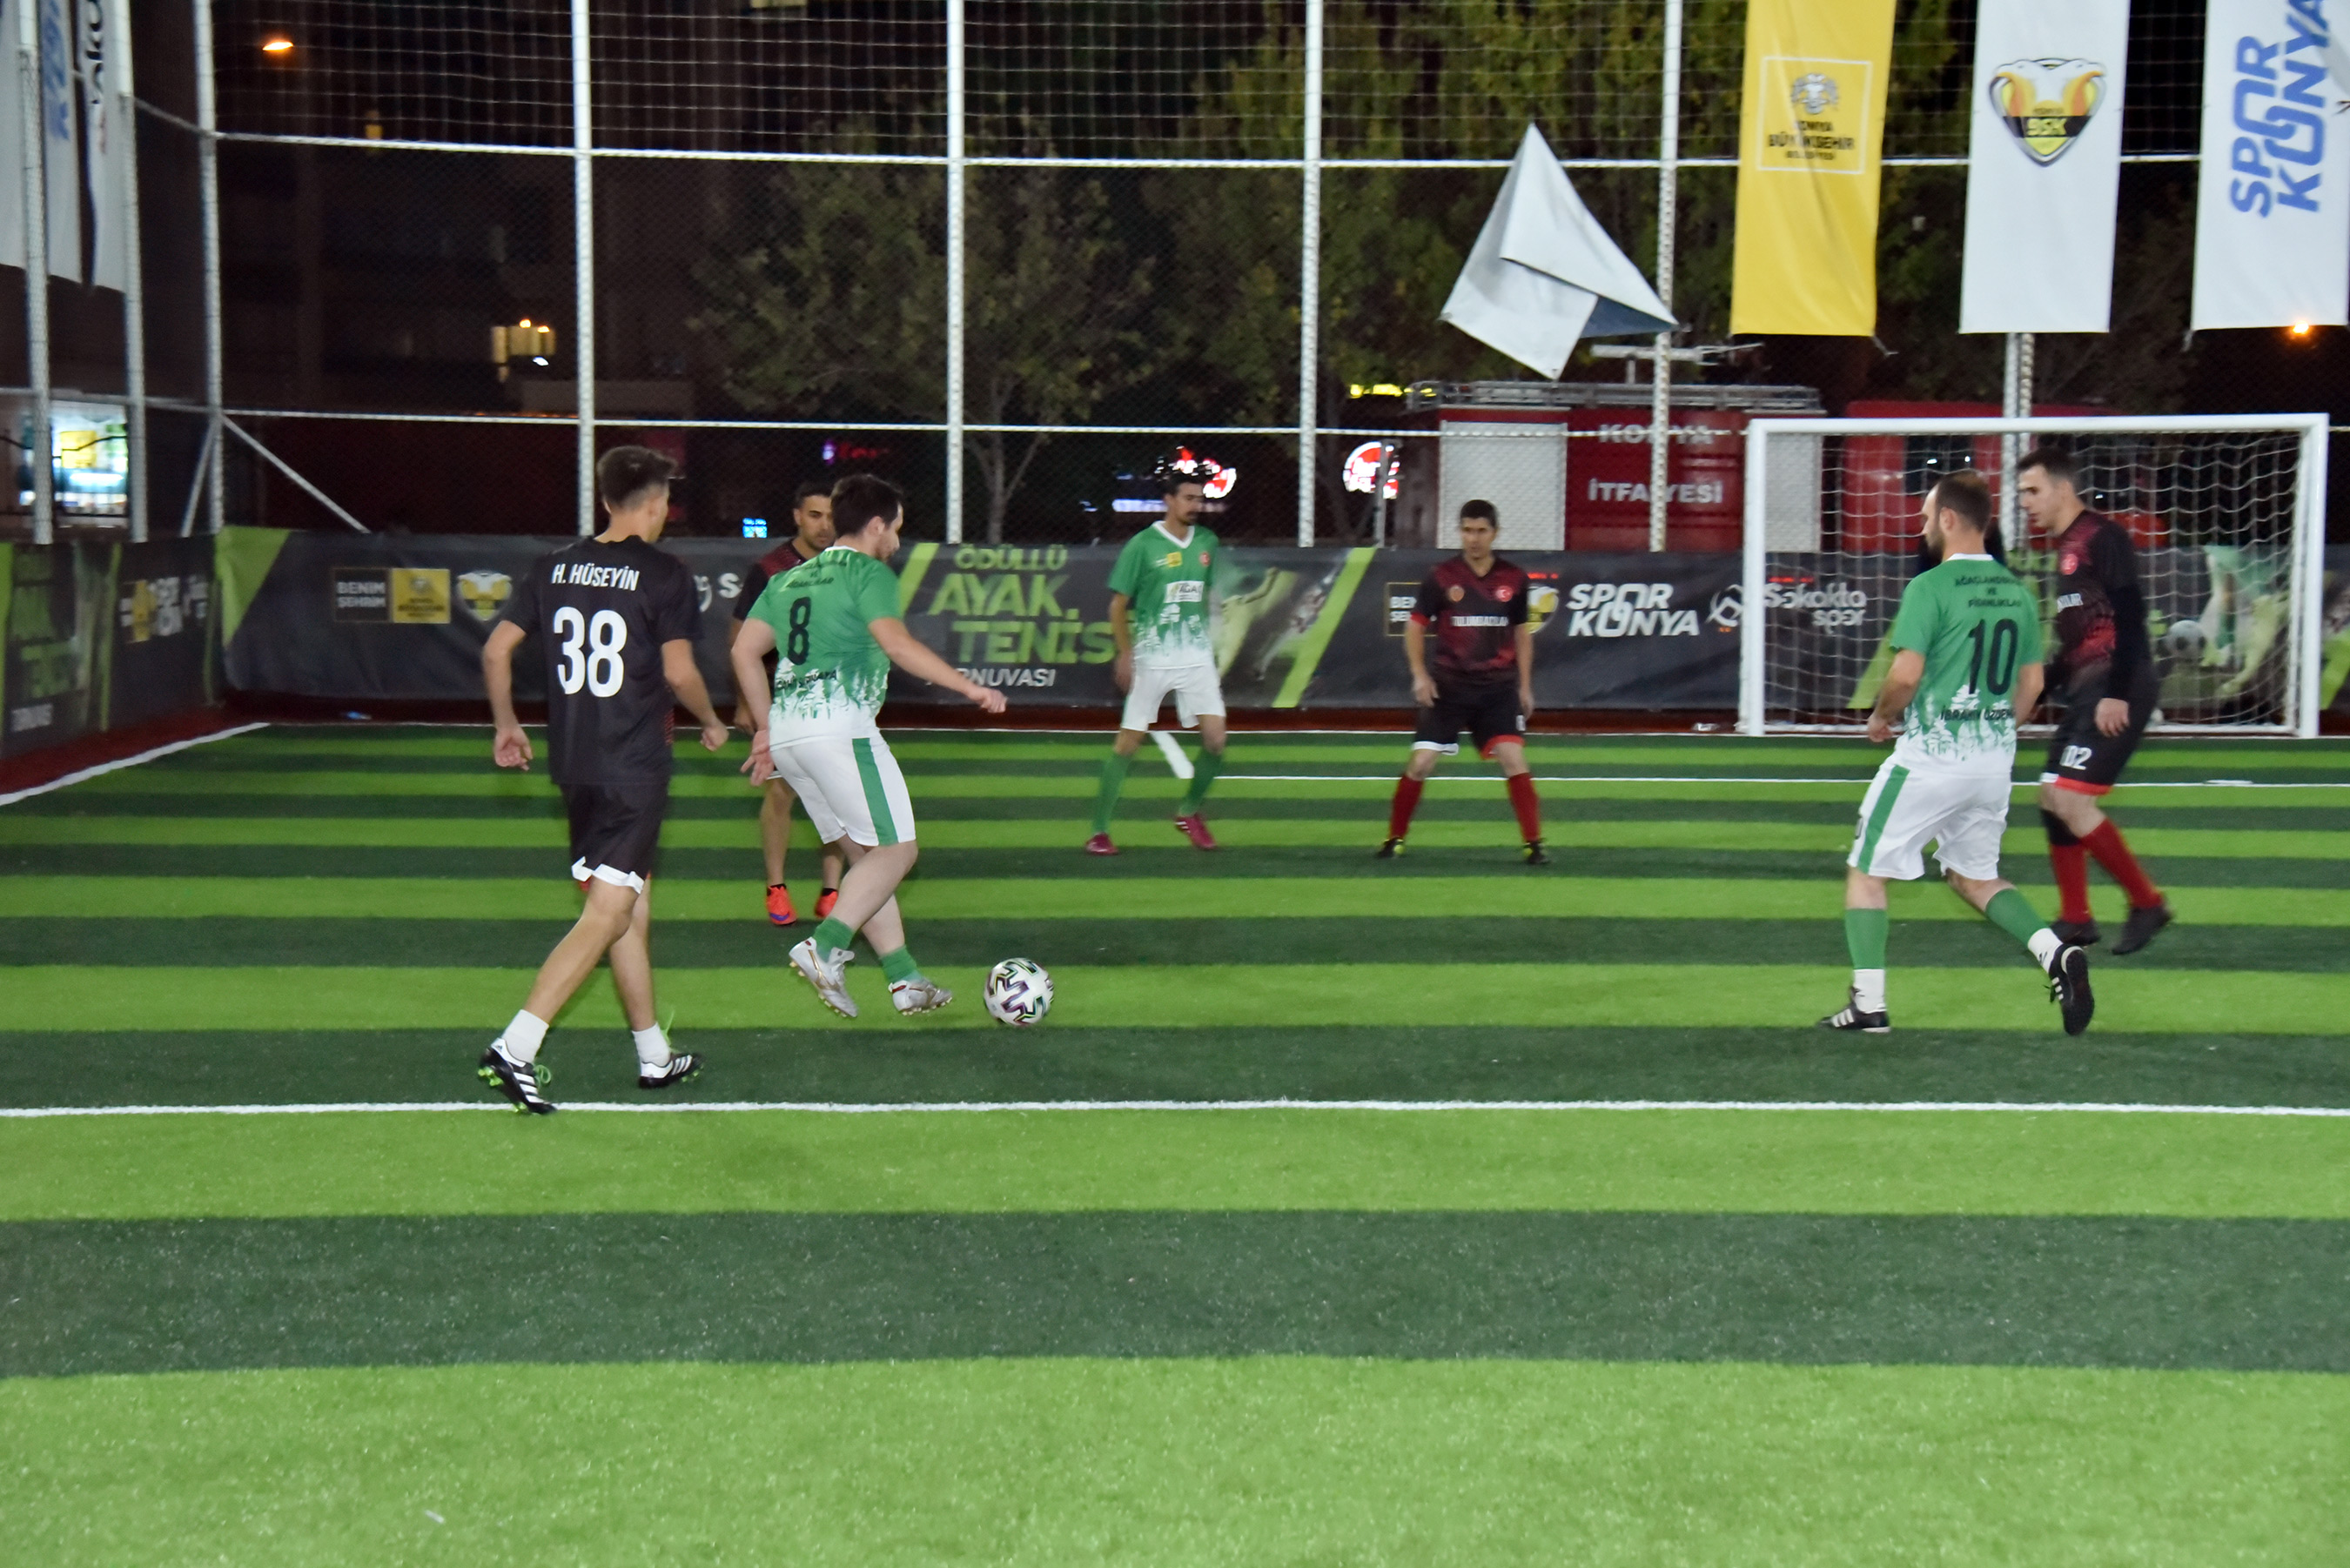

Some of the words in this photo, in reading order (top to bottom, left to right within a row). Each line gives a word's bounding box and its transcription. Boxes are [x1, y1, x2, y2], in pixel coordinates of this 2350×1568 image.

[2229, 36, 2296, 218] SPOR
[551, 563, 567, 584] H.
[568, 563, 640, 592] HÜSEYİN
[954, 544, 1068, 571] ÖDÜLLÜ
[928, 573, 1070, 617] AYAK
[1566, 582, 1674, 623] SPOR
[788, 596, 812, 666] 8
[1568, 600, 1700, 638] KONYA
[553, 606, 628, 698] 38
[1968, 619, 2018, 696] 10
